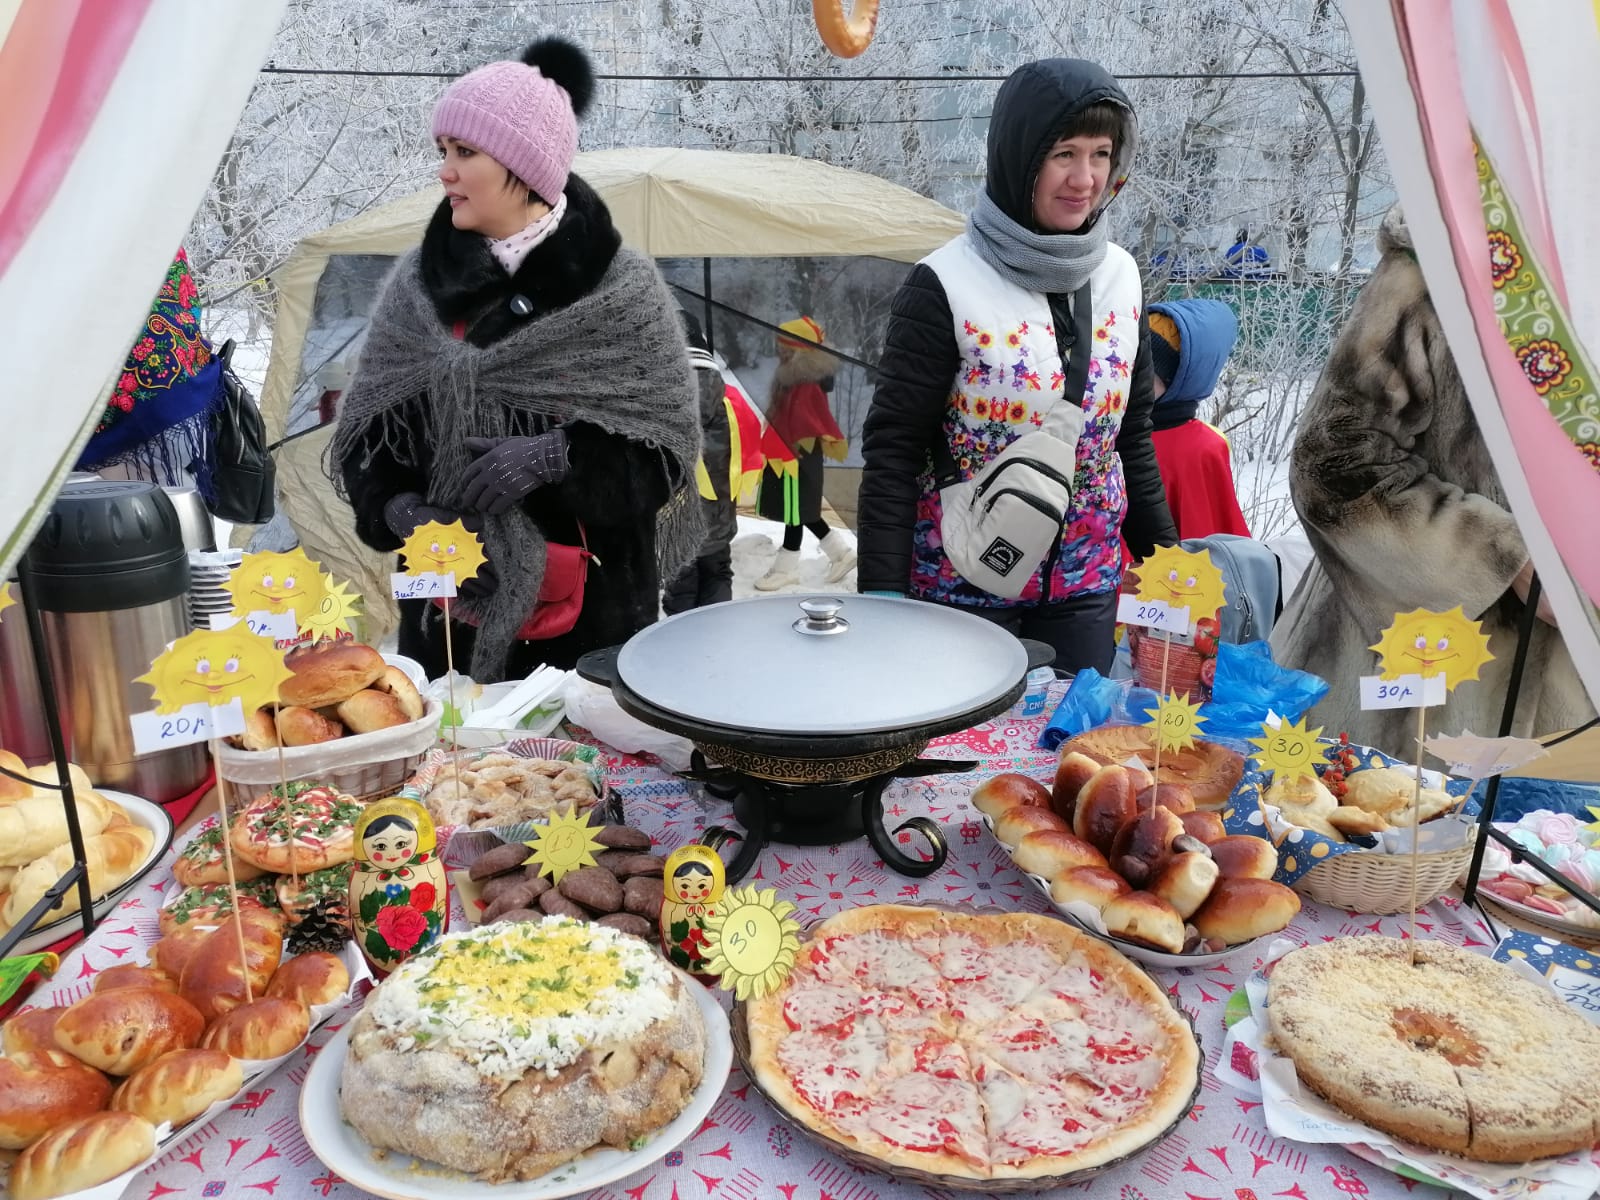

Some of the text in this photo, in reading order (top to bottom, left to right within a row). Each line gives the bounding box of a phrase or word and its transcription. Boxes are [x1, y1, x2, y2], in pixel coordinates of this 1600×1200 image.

[1163, 714, 1184, 728] 20
[1272, 738, 1304, 757] 30
[550, 830, 577, 854] 15
[729, 919, 757, 955] 30
